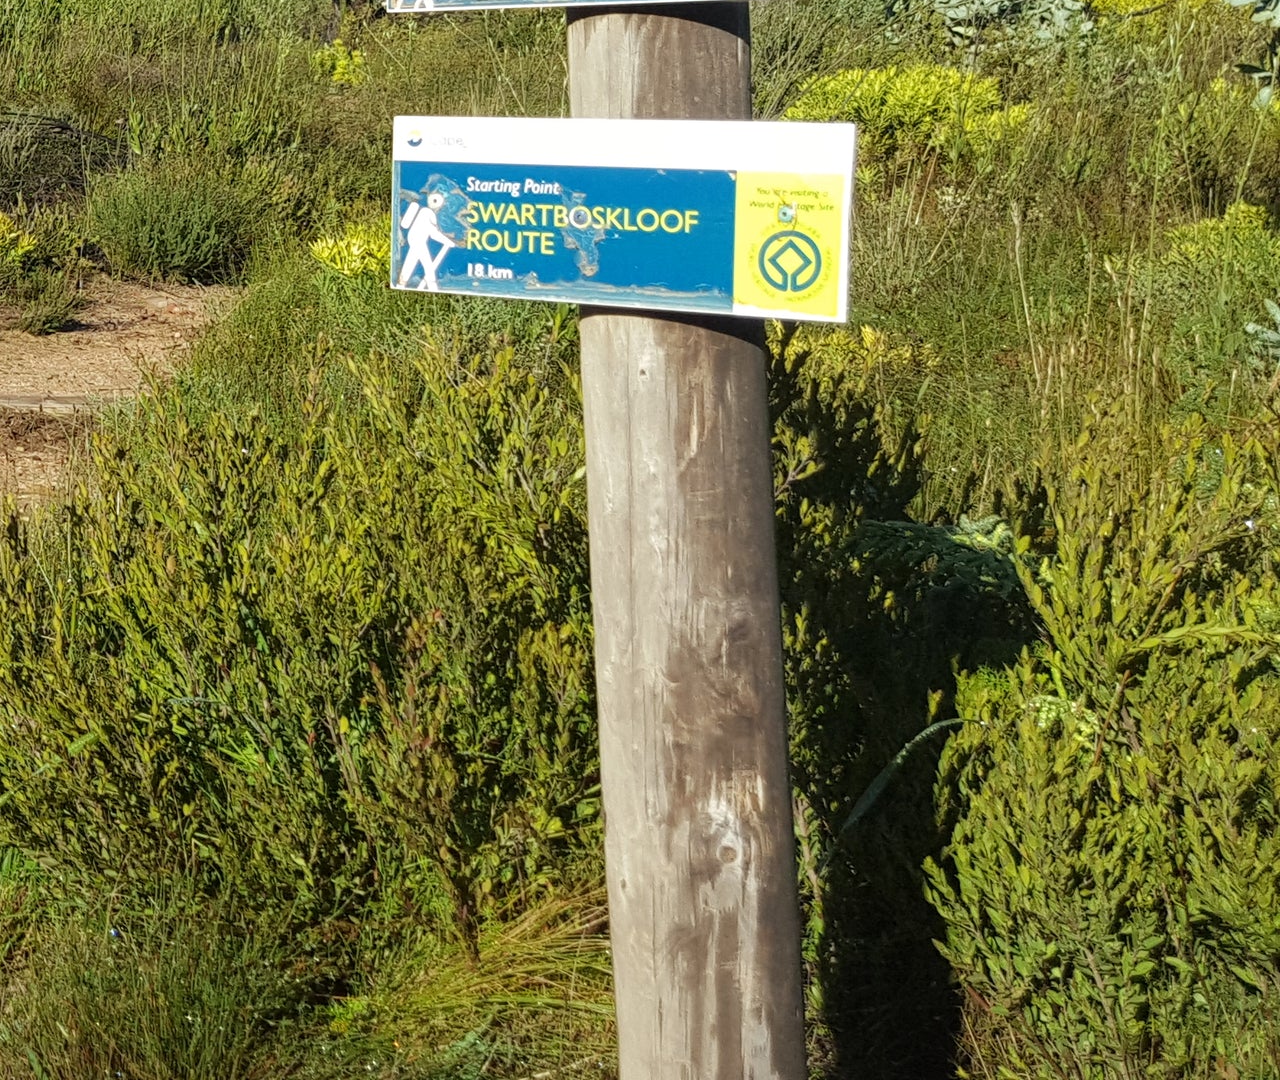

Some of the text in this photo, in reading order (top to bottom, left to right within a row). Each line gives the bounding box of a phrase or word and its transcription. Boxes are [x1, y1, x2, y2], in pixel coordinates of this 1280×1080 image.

[466, 176, 561, 198] Starting Point
[466, 201, 699, 234] SWARTBOSKLOOF
[466, 228, 555, 255] ROUTE
[467, 263, 513, 279] 18 km
